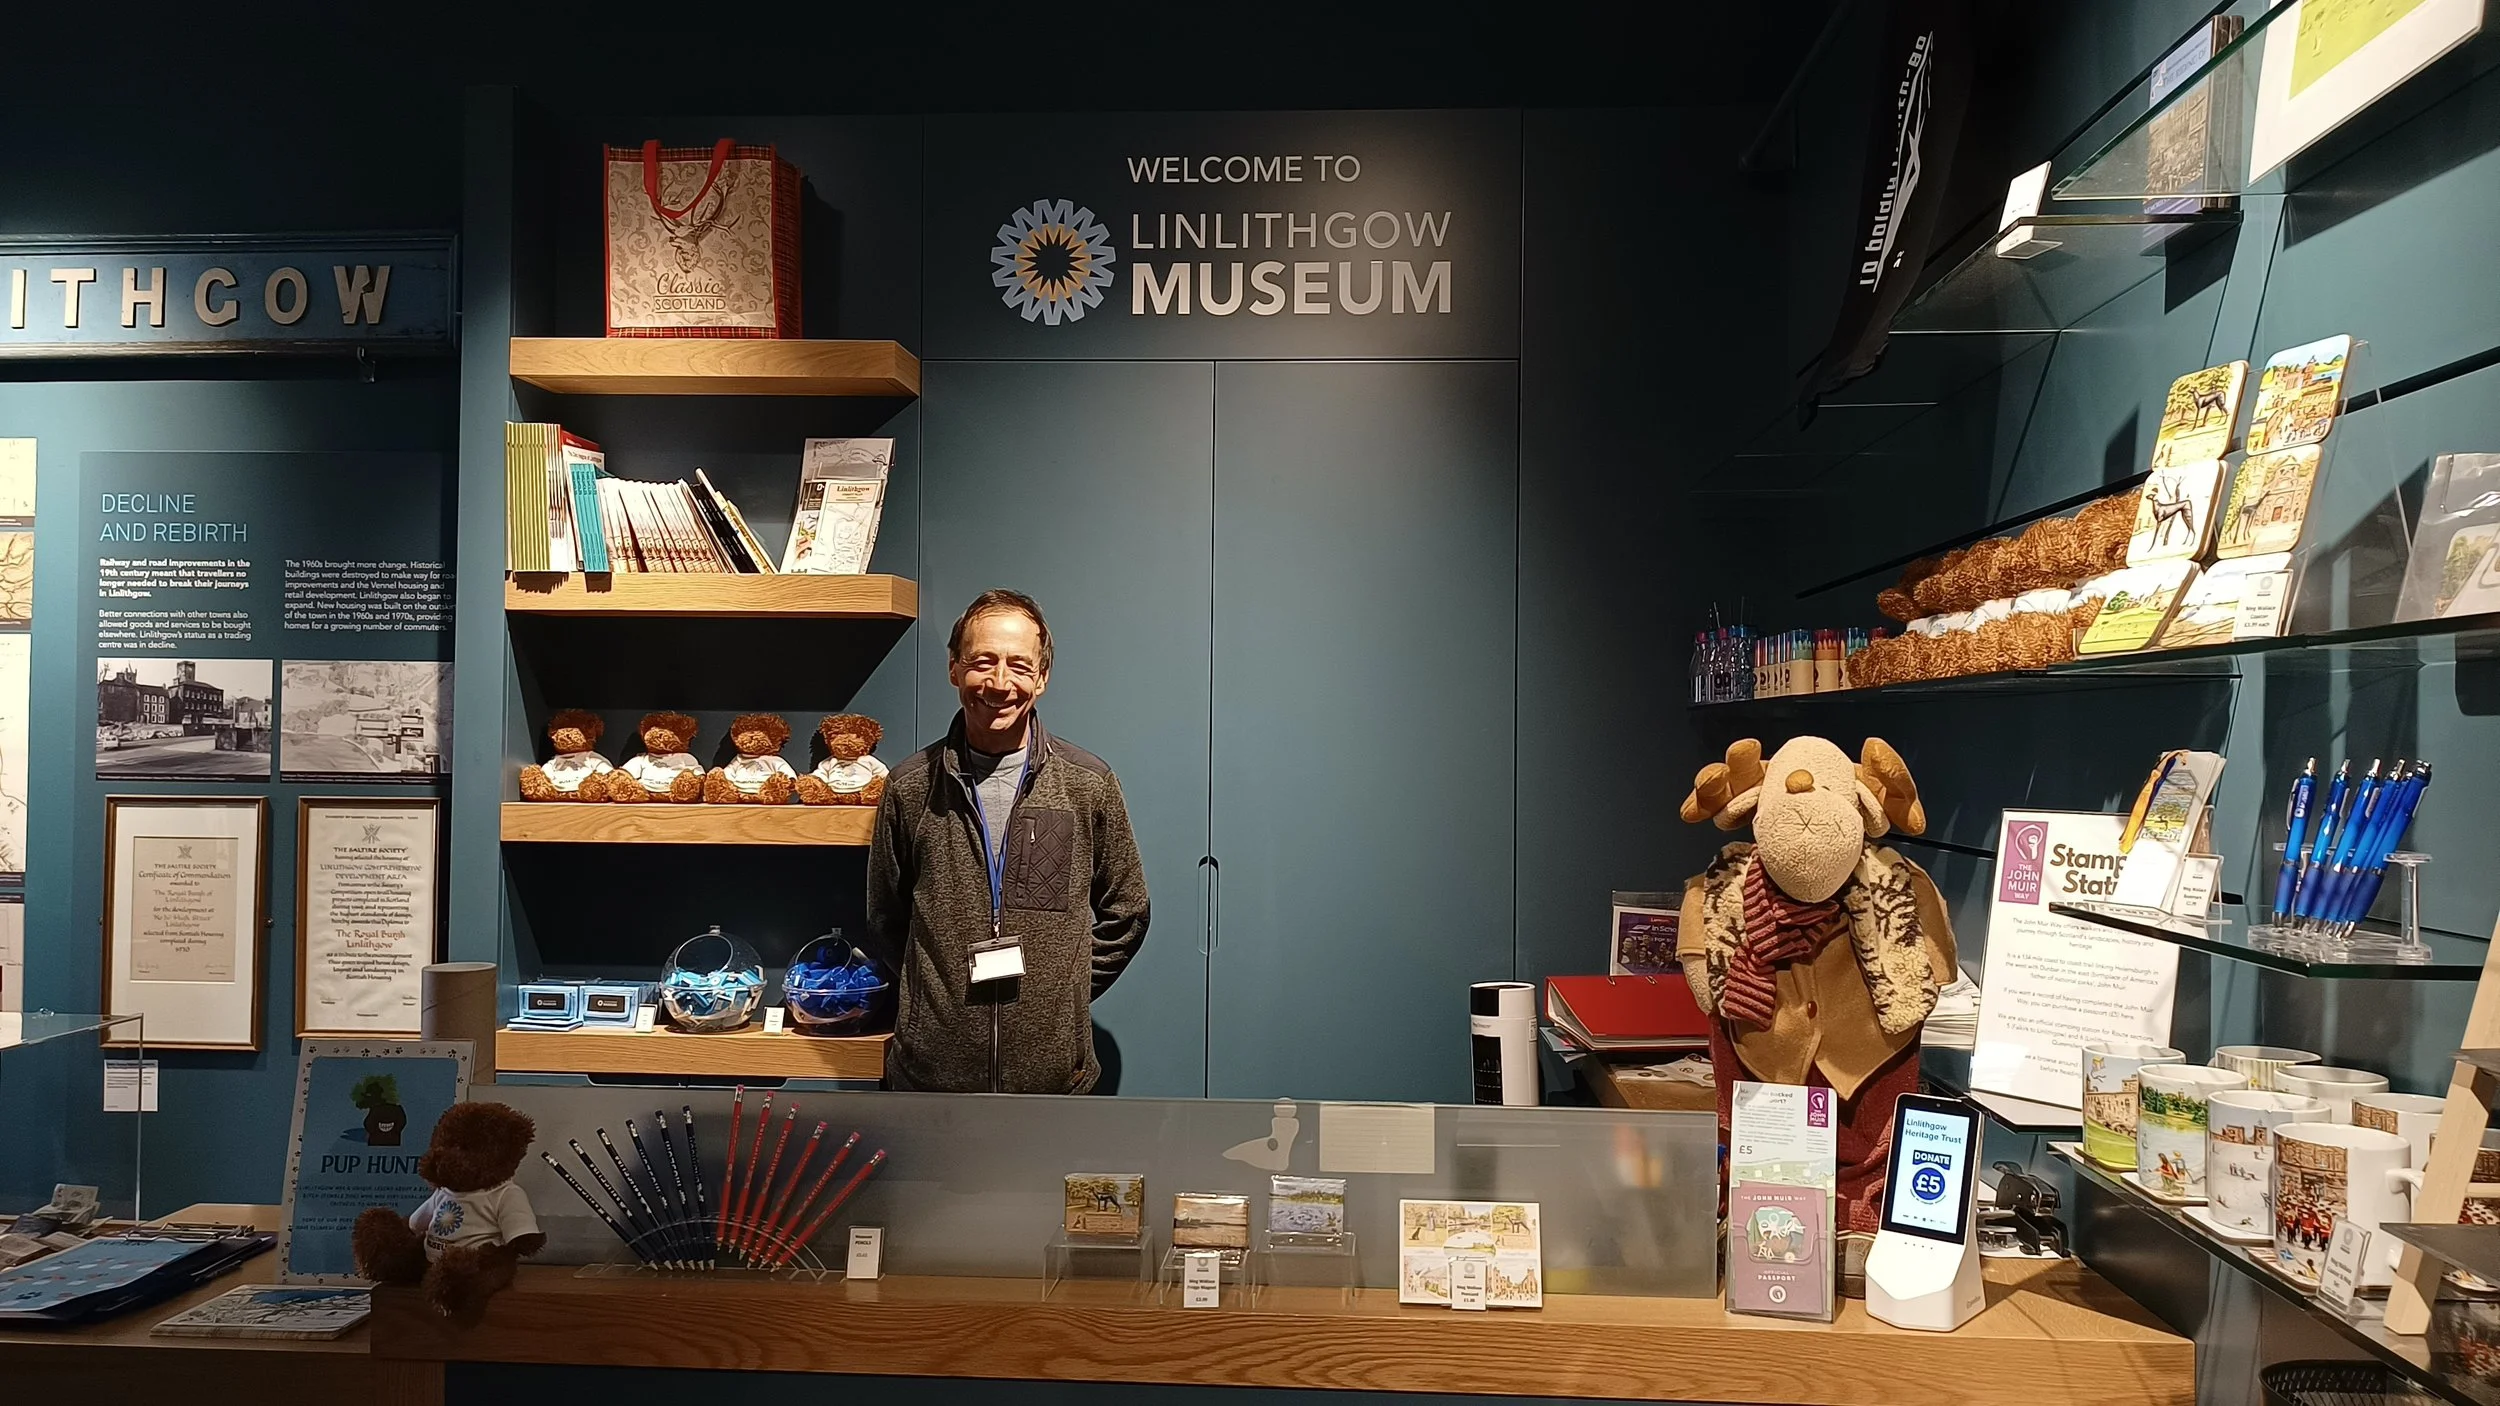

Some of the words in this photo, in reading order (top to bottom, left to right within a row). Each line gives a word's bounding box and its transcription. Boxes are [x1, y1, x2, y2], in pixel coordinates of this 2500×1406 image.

[1127, 155, 1303, 184] WELCOME
[1313, 154, 1362, 183] TO
[1131, 211, 1453, 250] LINLITHGOW
[657, 272, 720, 295] Classic
[1130, 261, 1453, 316] MUSEUM
[10, 265, 391, 329] ITHGOW
[655, 298, 726, 310] SCOTLAND
[101, 493, 196, 514] DECLINE
[99, 522, 147, 543] AND
[153, 522, 248, 543] REBIRTH
[100, 559, 130, 568] Railway
[168, 559, 225, 568] improvements
[324, 560, 355, 569] brought
[119, 570, 150, 578] century
[285, 570, 319, 580] buildings
[341, 571, 379, 580] destroyed
[390, 571, 411, 579] make
[99, 580, 125, 588] longer
[214, 580, 249, 589] journeys
[285, 581, 338, 590] improvements
[340, 581, 355, 589] and
[398, 582, 428, 591] housing
[359, 592, 398, 601] Linlithgow
[416, 592, 441, 602] began
[336, 602, 366, 611] housing
[383, 602, 401, 610] built
[169, 610, 185, 618] with
[187, 610, 207, 618] other
[209, 610, 231, 618] towns
[352, 612, 373, 620] 1960s
[129, 620, 153, 629] goods
[223, 621, 251, 630] bought
[330, 622, 361, 632] growing
[224, 631, 251, 640] trading
[2050, 843, 2127, 879] Stamp
[2018, 863, 2033, 872] THE
[2006, 870, 2041, 882] JOHN
[2007, 880, 2037, 893] MUIR
[2062, 870, 2118, 896] Stat
[2014, 892, 2030, 900] WAY
[336, 928, 352, 938] The
[354, 929, 379, 940] Royal
[381, 929, 406, 941] Burgh
[346, 939, 393, 951] Linlithgow
[1906, 1118, 1948, 1131] Linlithgow
[1905, 1128, 1939, 1141] Heritage
[1941, 1133, 1962, 1144] Trust
[1739, 1145, 1753, 1155] £5
[1914, 1151, 1951, 1165] DONATE
[321, 1155, 361, 1174] PUP
[367, 1155, 419, 1175] HUNT
[1915, 1173, 1941, 1194] £5
